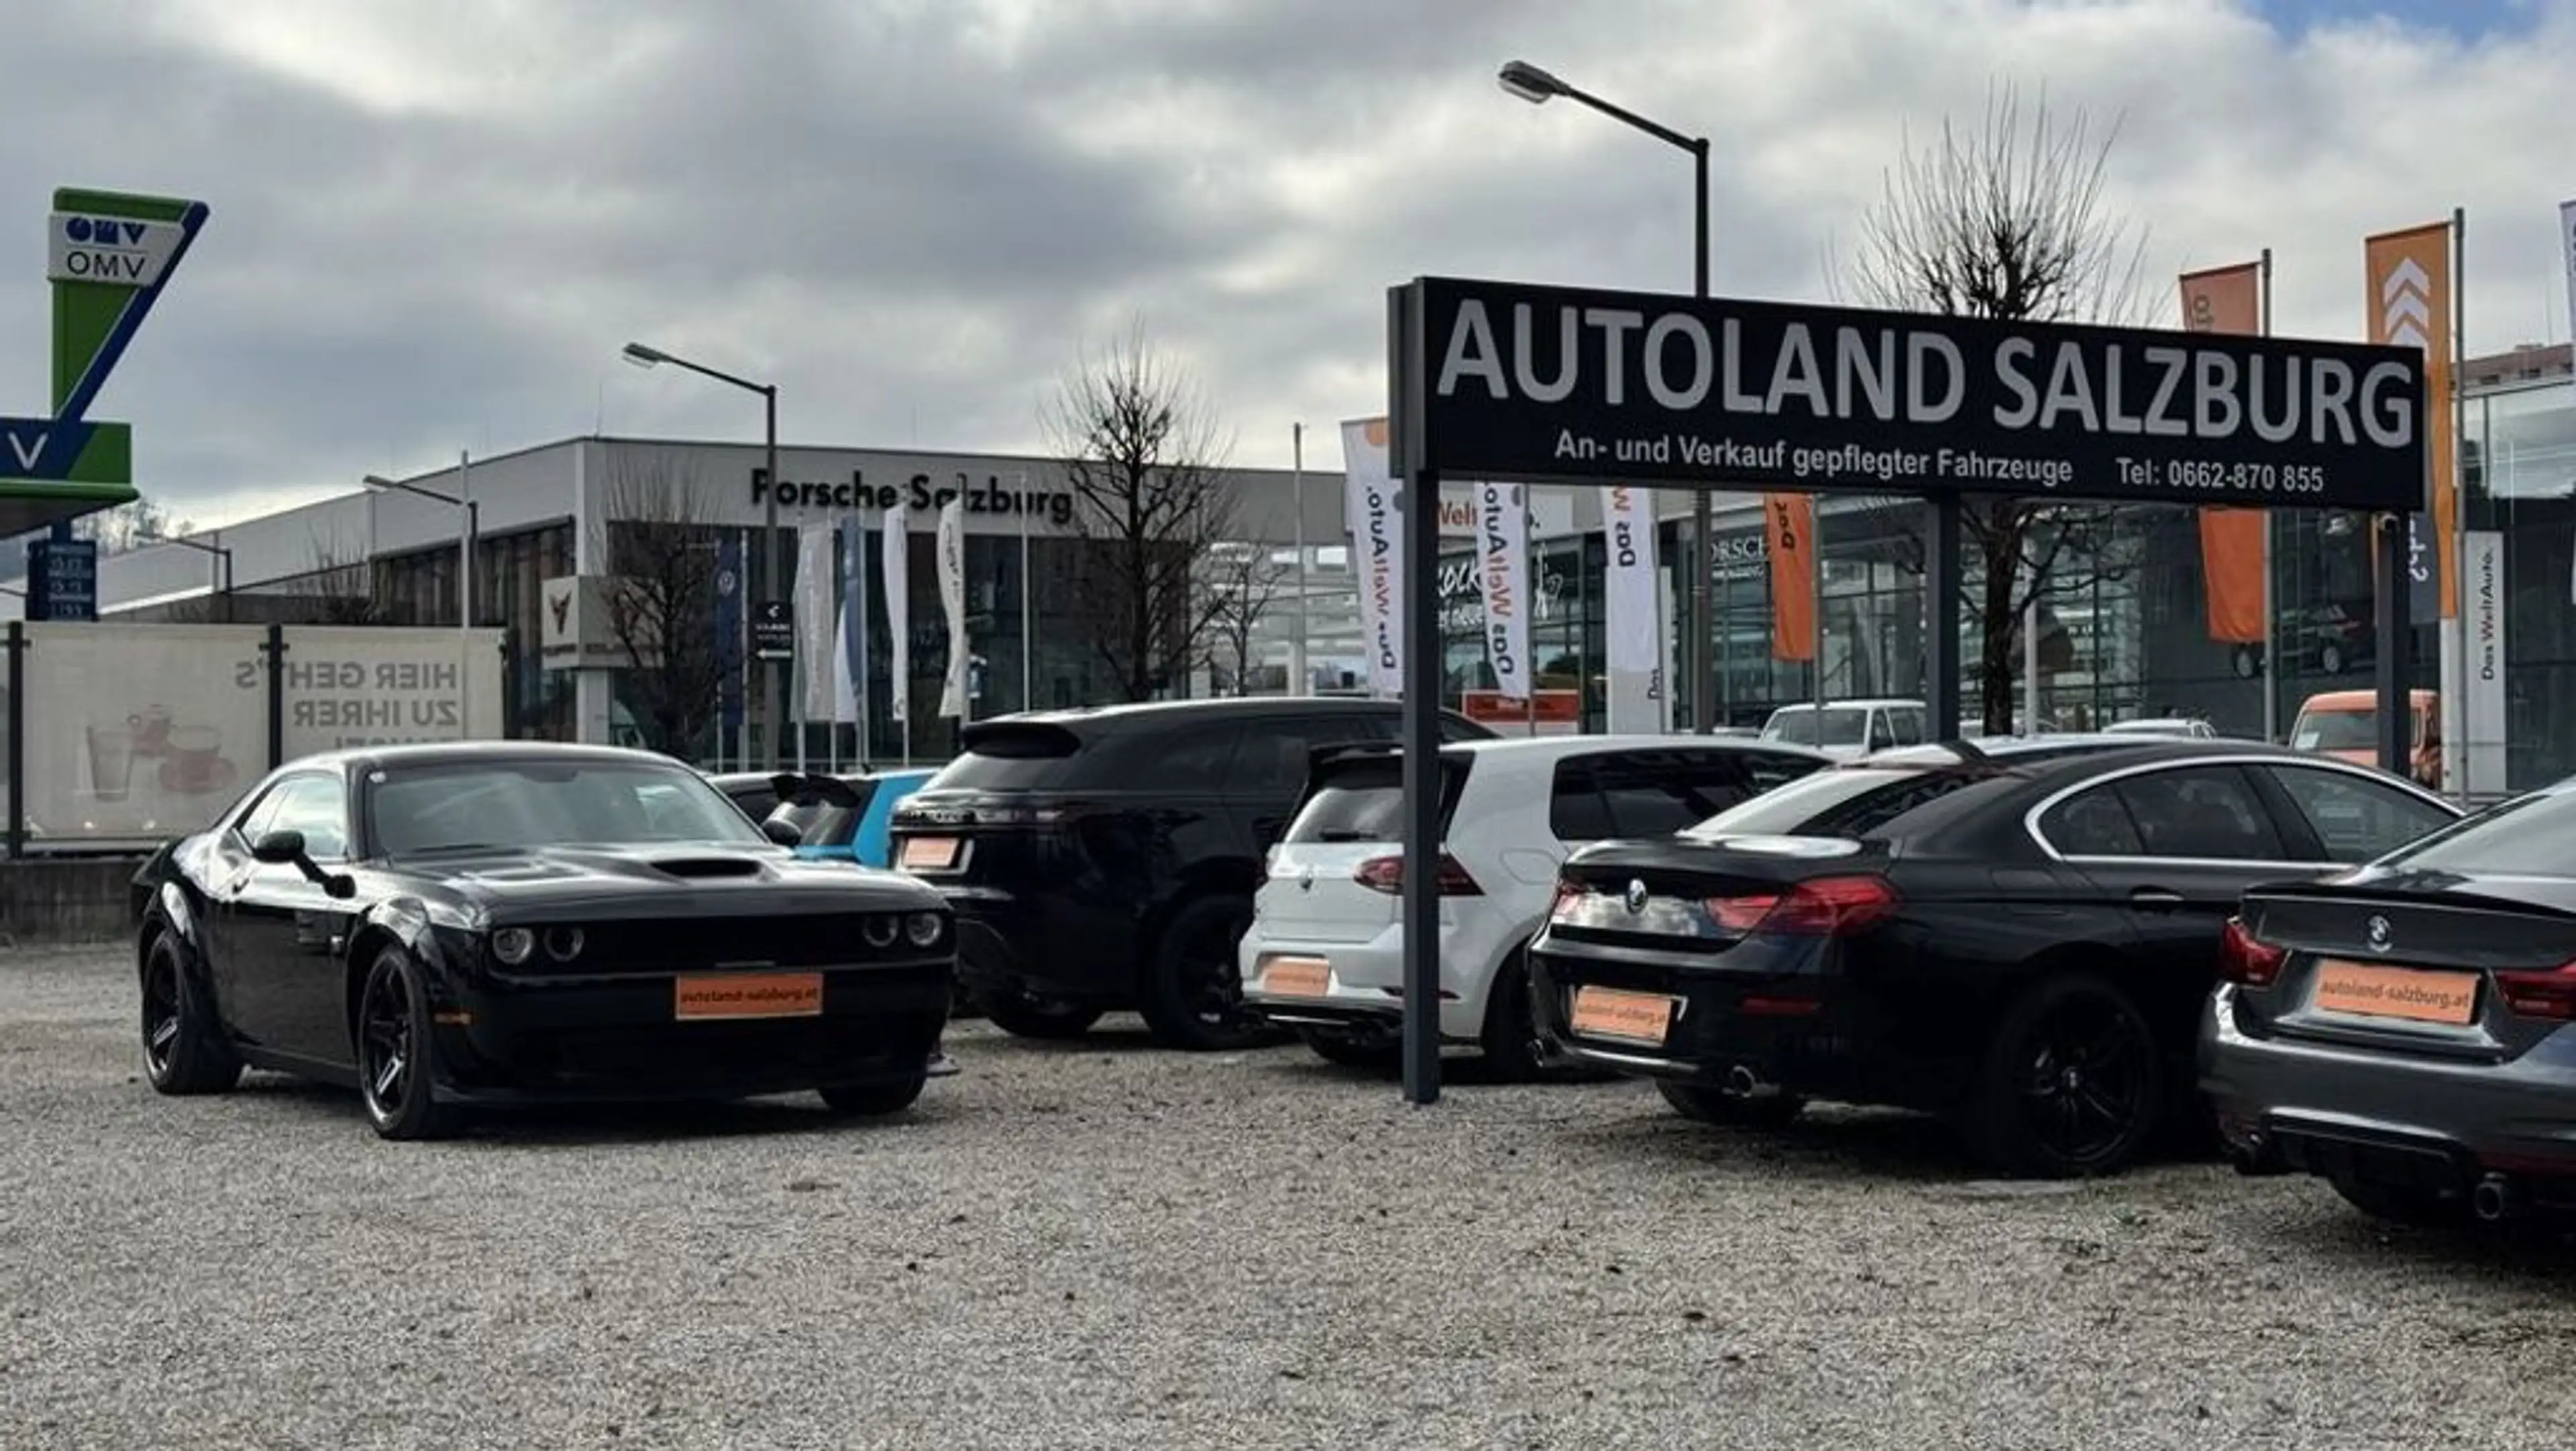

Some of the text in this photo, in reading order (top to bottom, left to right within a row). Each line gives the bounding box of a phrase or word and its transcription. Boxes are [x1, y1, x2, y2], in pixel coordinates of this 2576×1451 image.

[66, 217, 146, 246] OMV
[67, 251, 146, 279] OMV
[1436, 299, 2413, 449] AUTOLAND SALZBURG
[1554, 428, 2324, 492] An- und Verkauf gepflegter Fahrzeuge Tel: 0662-870 855
[750, 468, 1072, 524] Porsche Salzburg
[2479, 549, 2495, 680] Das WeltAuto.
[2319, 979, 2471, 1010] autoland-salzburg.at
